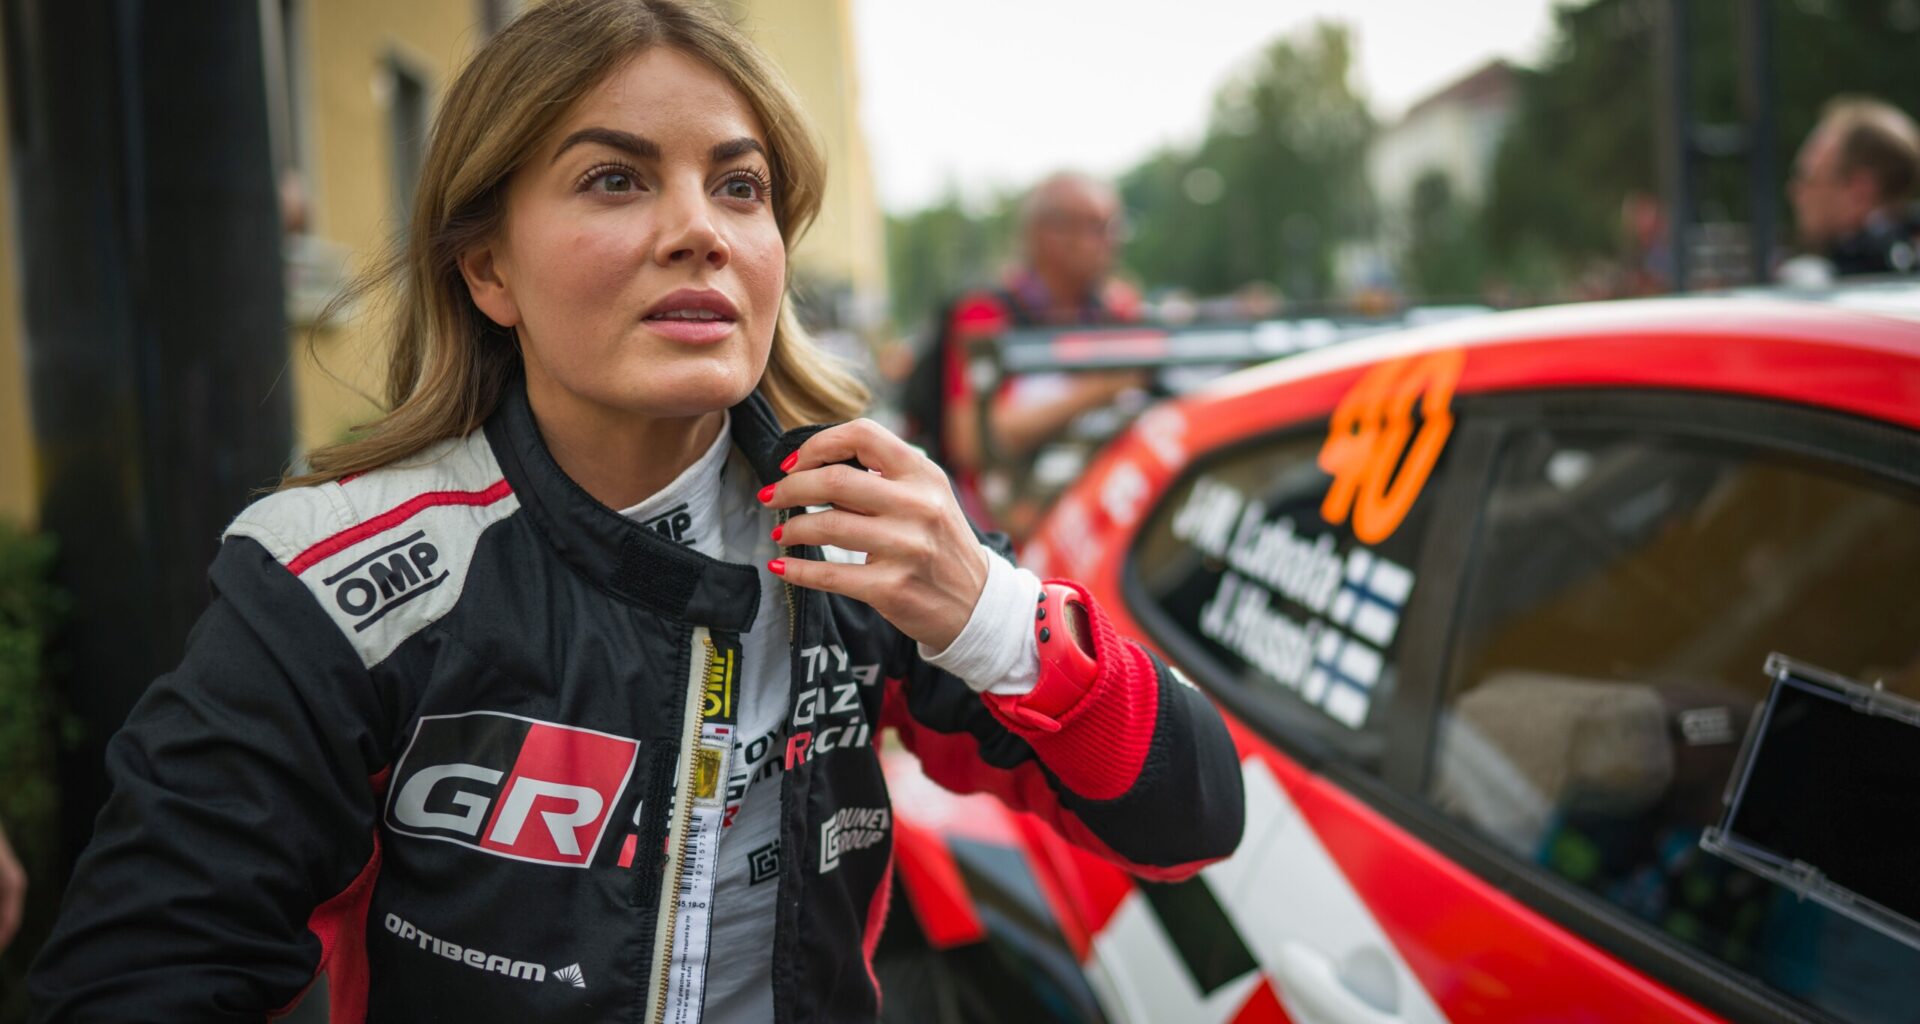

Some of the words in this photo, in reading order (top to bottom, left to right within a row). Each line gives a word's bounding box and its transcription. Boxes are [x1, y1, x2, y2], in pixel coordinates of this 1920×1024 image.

[1317, 349, 1467, 544] 40
[335, 541, 439, 617] OMP
[394, 762, 604, 856] GR
[384, 912, 547, 982] OPTIBEAM
